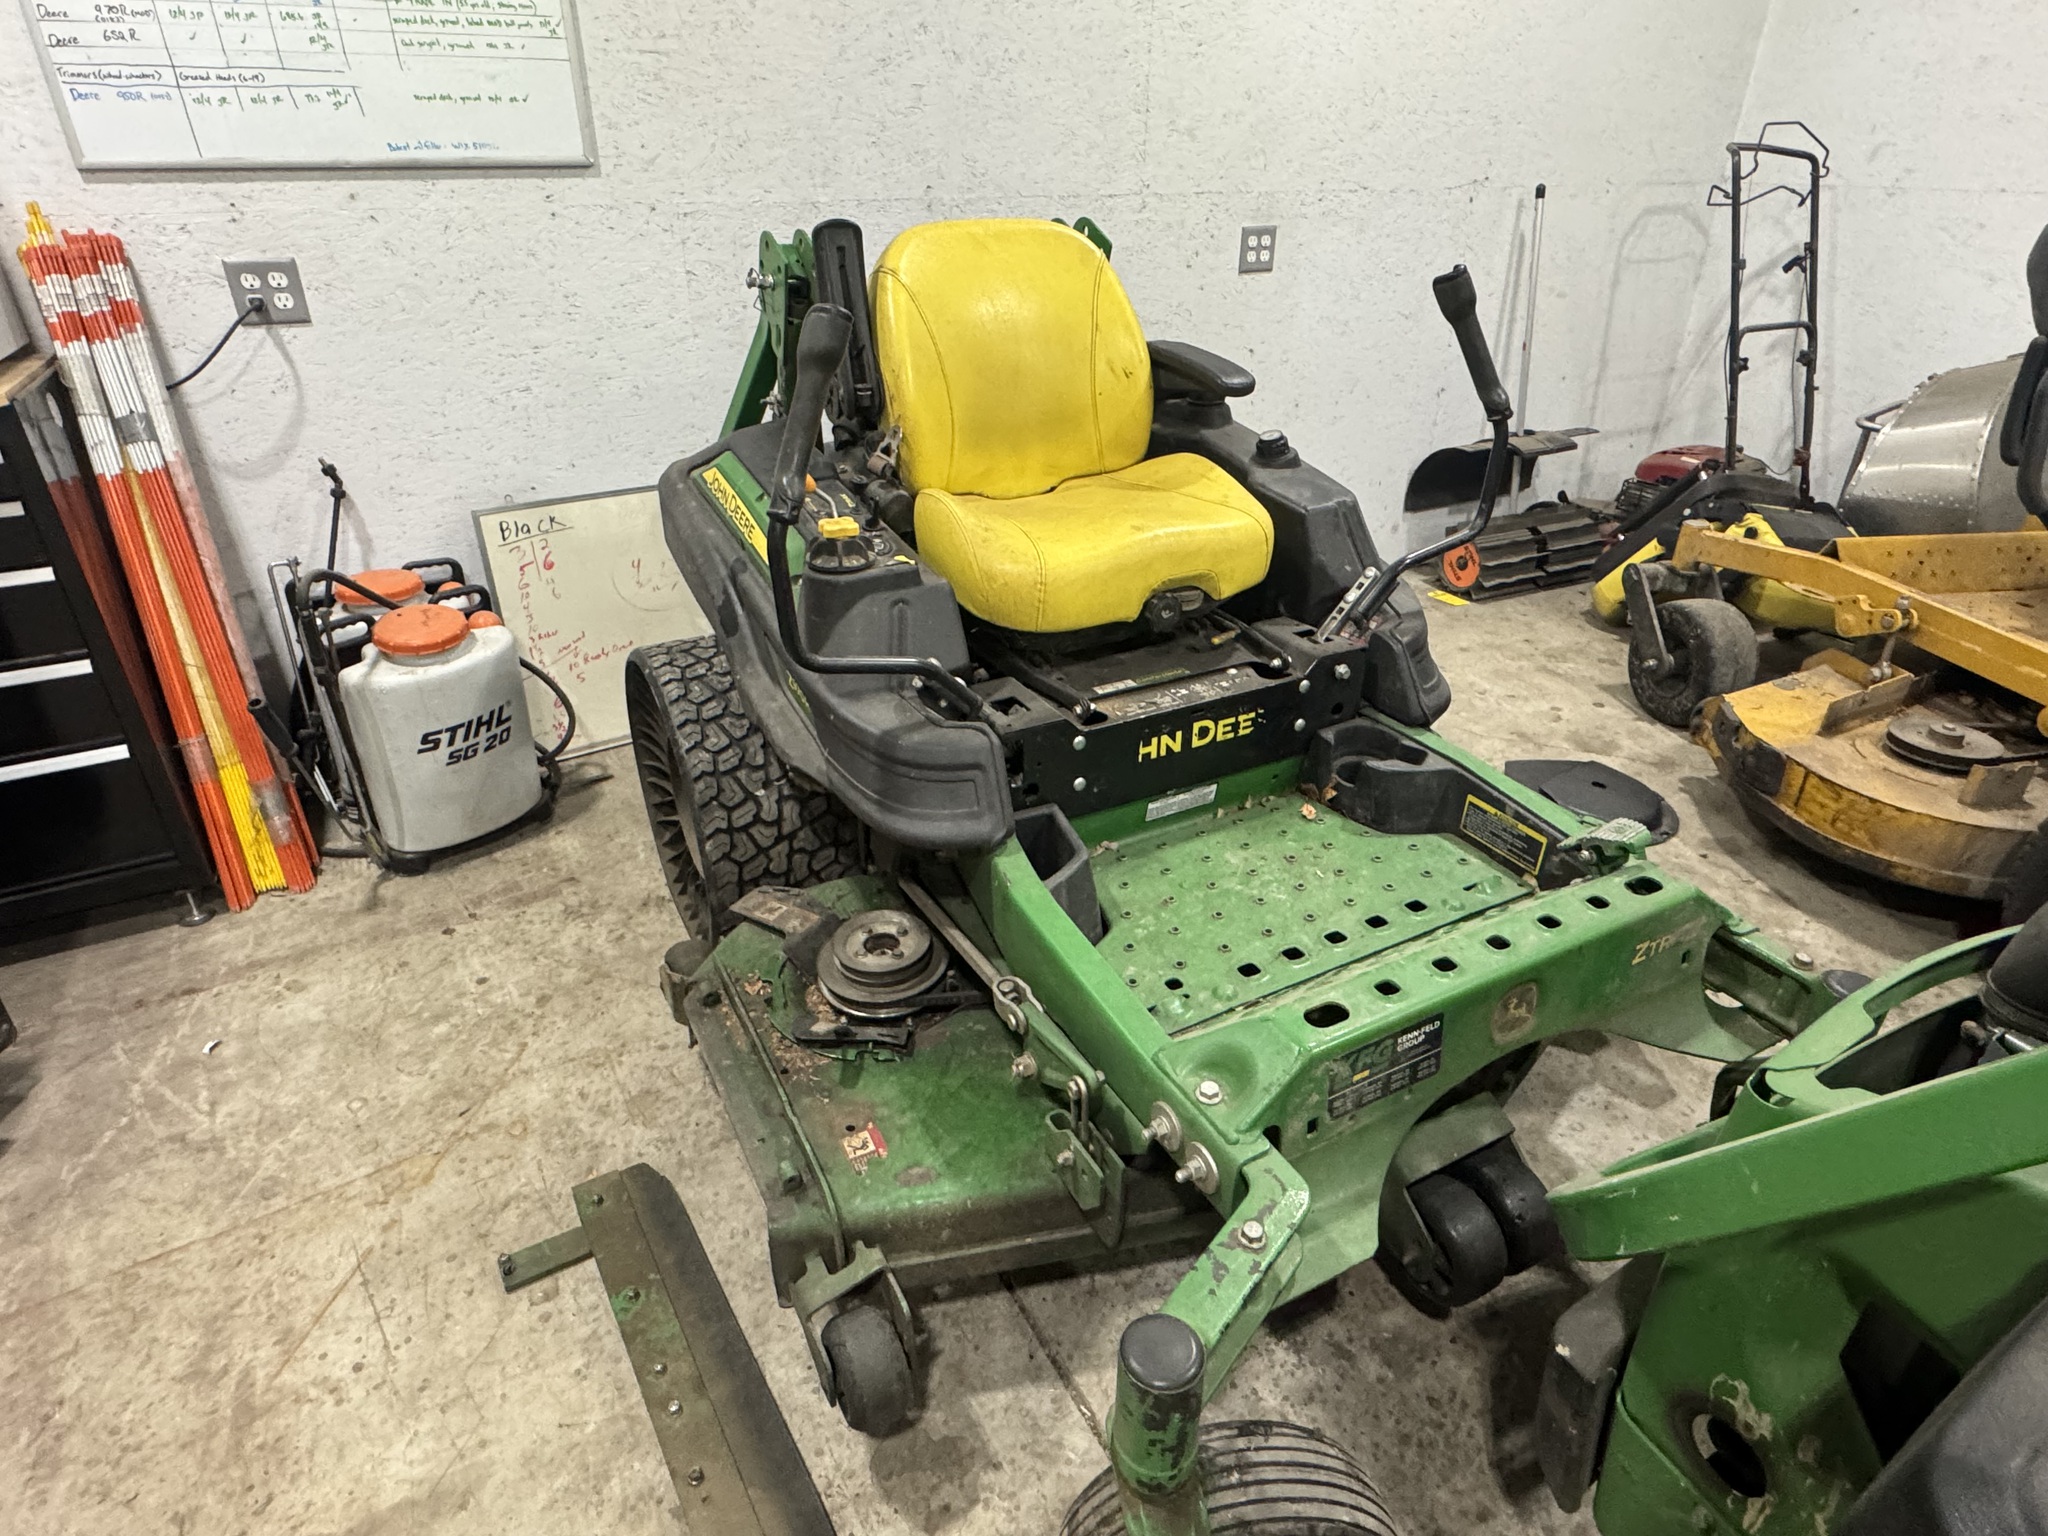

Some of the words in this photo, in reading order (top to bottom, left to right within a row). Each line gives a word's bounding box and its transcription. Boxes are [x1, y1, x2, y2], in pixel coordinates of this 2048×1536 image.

[37, 4, 69, 18] Deere
[49, 34, 80, 48] Deere
[69, 88, 101, 102] Deere
[708, 471, 730, 507] JOHN
[728, 494, 756, 541] DEERE
[499, 515, 567, 542] Black
[543, 550, 555, 571] 6
[417, 704, 512, 754] STIHL
[446, 741, 480, 766] SG
[483, 725, 512, 753] 20
[1397, 1034, 1426, 1053] GROUP
